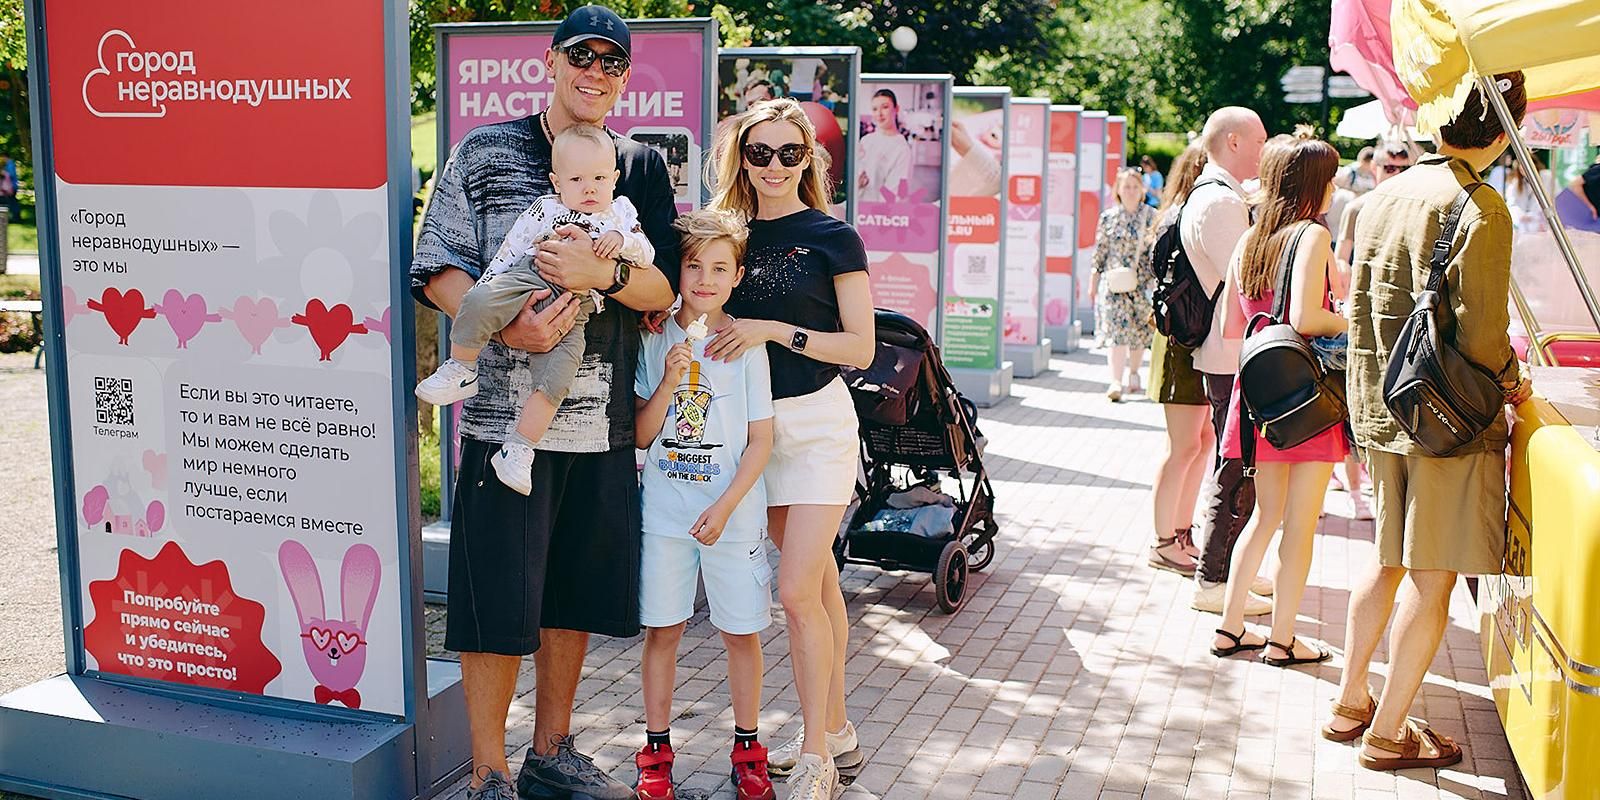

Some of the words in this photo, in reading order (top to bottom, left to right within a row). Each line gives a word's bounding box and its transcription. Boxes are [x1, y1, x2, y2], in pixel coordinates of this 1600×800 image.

[116, 50, 197, 78] город
[459, 58, 555, 84] ЯРКО
[118, 77, 352, 107] неравнодушных
[460, 91, 683, 117] НАСТНИЕ
[70, 208, 127, 228] «Город
[857, 214, 909, 227] САТЬСЯ
[949, 213, 995, 227] ЛЬНЫЙ
[71, 235, 219, 255] неравнодушных»
[72, 258, 99, 273] это
[103, 259, 128, 274] мы
[180, 383, 221, 402] Если
[225, 389, 248, 404] вы
[252, 391, 280, 406] это
[284, 393, 359, 415] читаете,
[93, 426, 139, 439] Телеграм
[179, 409, 199, 424] то
[202, 411, 214, 425] и
[218, 412, 250, 428] вам
[255, 415, 277, 430] не
[281, 416, 311, 432] всё
[316, 420, 376, 439] равно!
[182, 430, 210, 448] Мы
[215, 437, 274, 454] можем
[279, 443, 350, 462] сделать
[677, 453, 712, 464] BIGGEST
[183, 457, 218, 473] мир
[222, 461, 297, 481] немного
[658, 459, 721, 475] BUBBLES
[667, 471, 678, 480] ON
[678, 473, 690, 481] THE
[183, 480, 243, 501] лучше,
[246, 487, 288, 504] если
[185, 504, 296, 530] постараемся
[301, 517, 364, 536] вместе
[122, 589, 220, 617] Попробуйте
[120, 611, 171, 633] прямо
[173, 618, 231, 640] сейчас
[125, 633, 136, 646] и
[139, 634, 228, 662] убедитесь,
[117, 652, 145, 667] что
[147, 656, 173, 671] это
[176, 661, 237, 681] просто!
